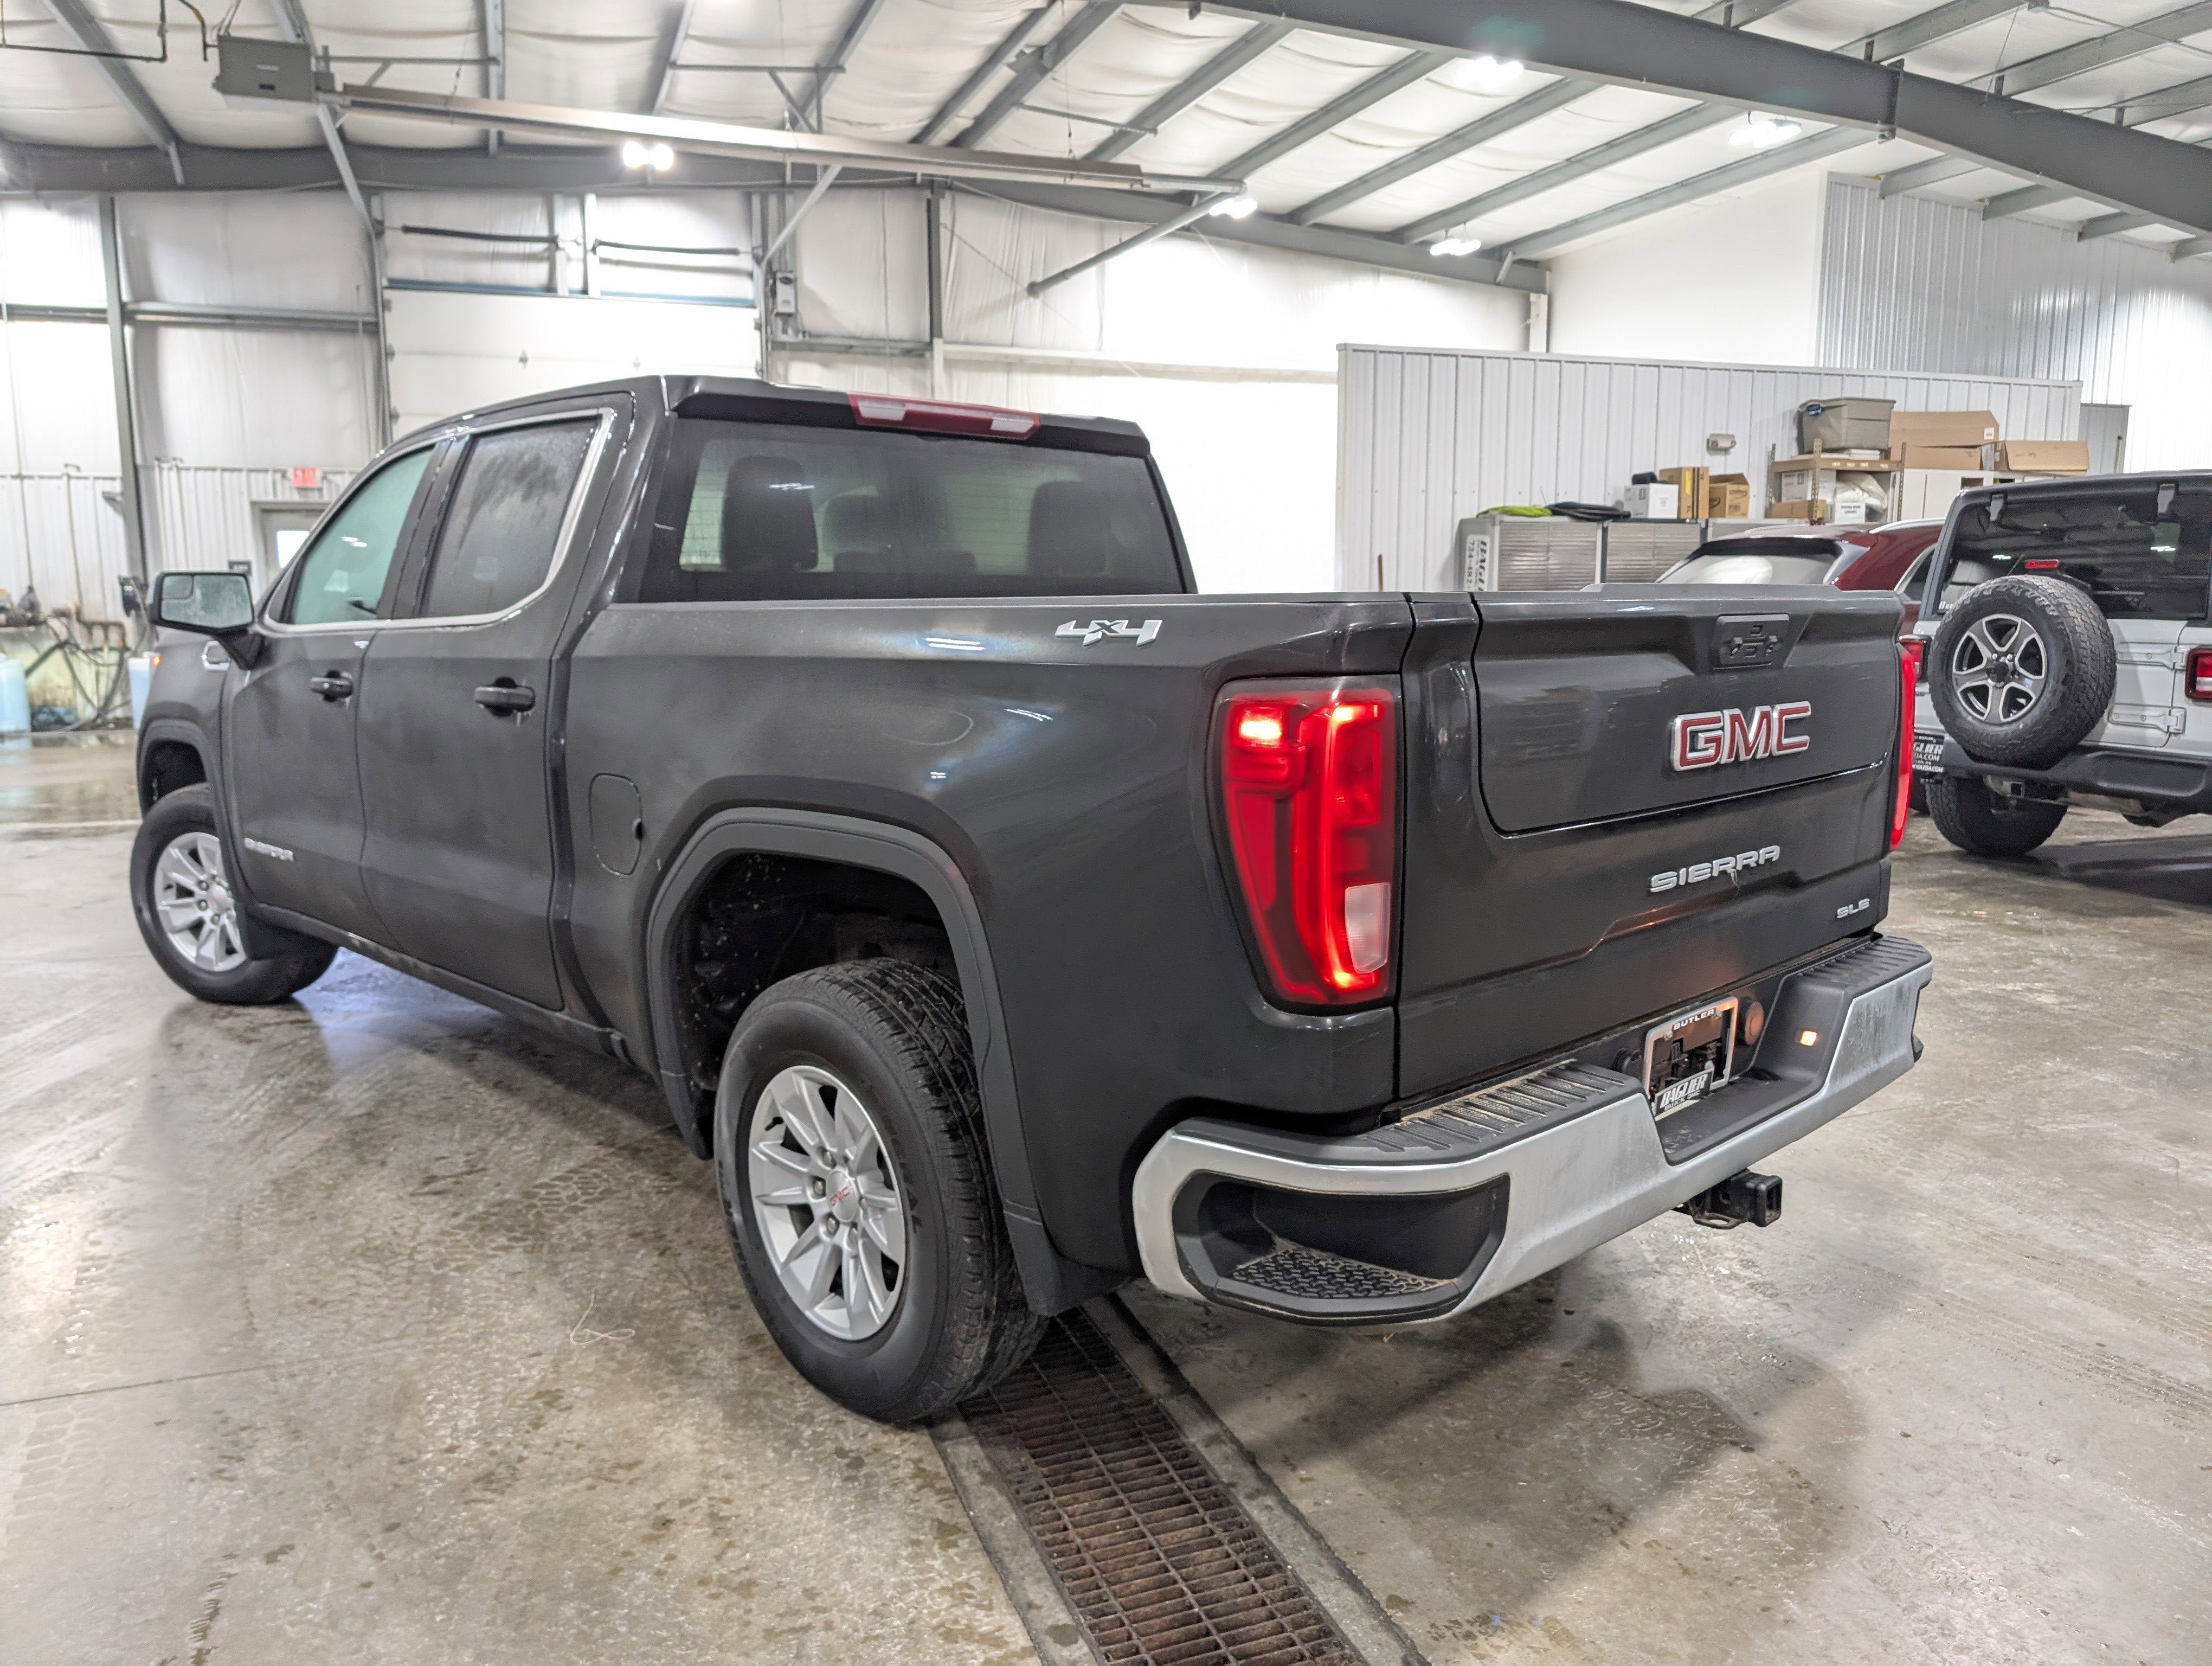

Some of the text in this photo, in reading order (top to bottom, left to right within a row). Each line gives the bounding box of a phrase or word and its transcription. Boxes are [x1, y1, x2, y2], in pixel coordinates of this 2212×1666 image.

[1670, 701, 1811, 772] GMC
[1650, 845, 1780, 893] SIERRA
[1837, 898, 1870, 919] SLE
[1673, 1008, 1715, 1030] BUTLER
[1660, 1073, 1708, 1108] BAGLIER
[829, 1186, 850, 1206] GMC
